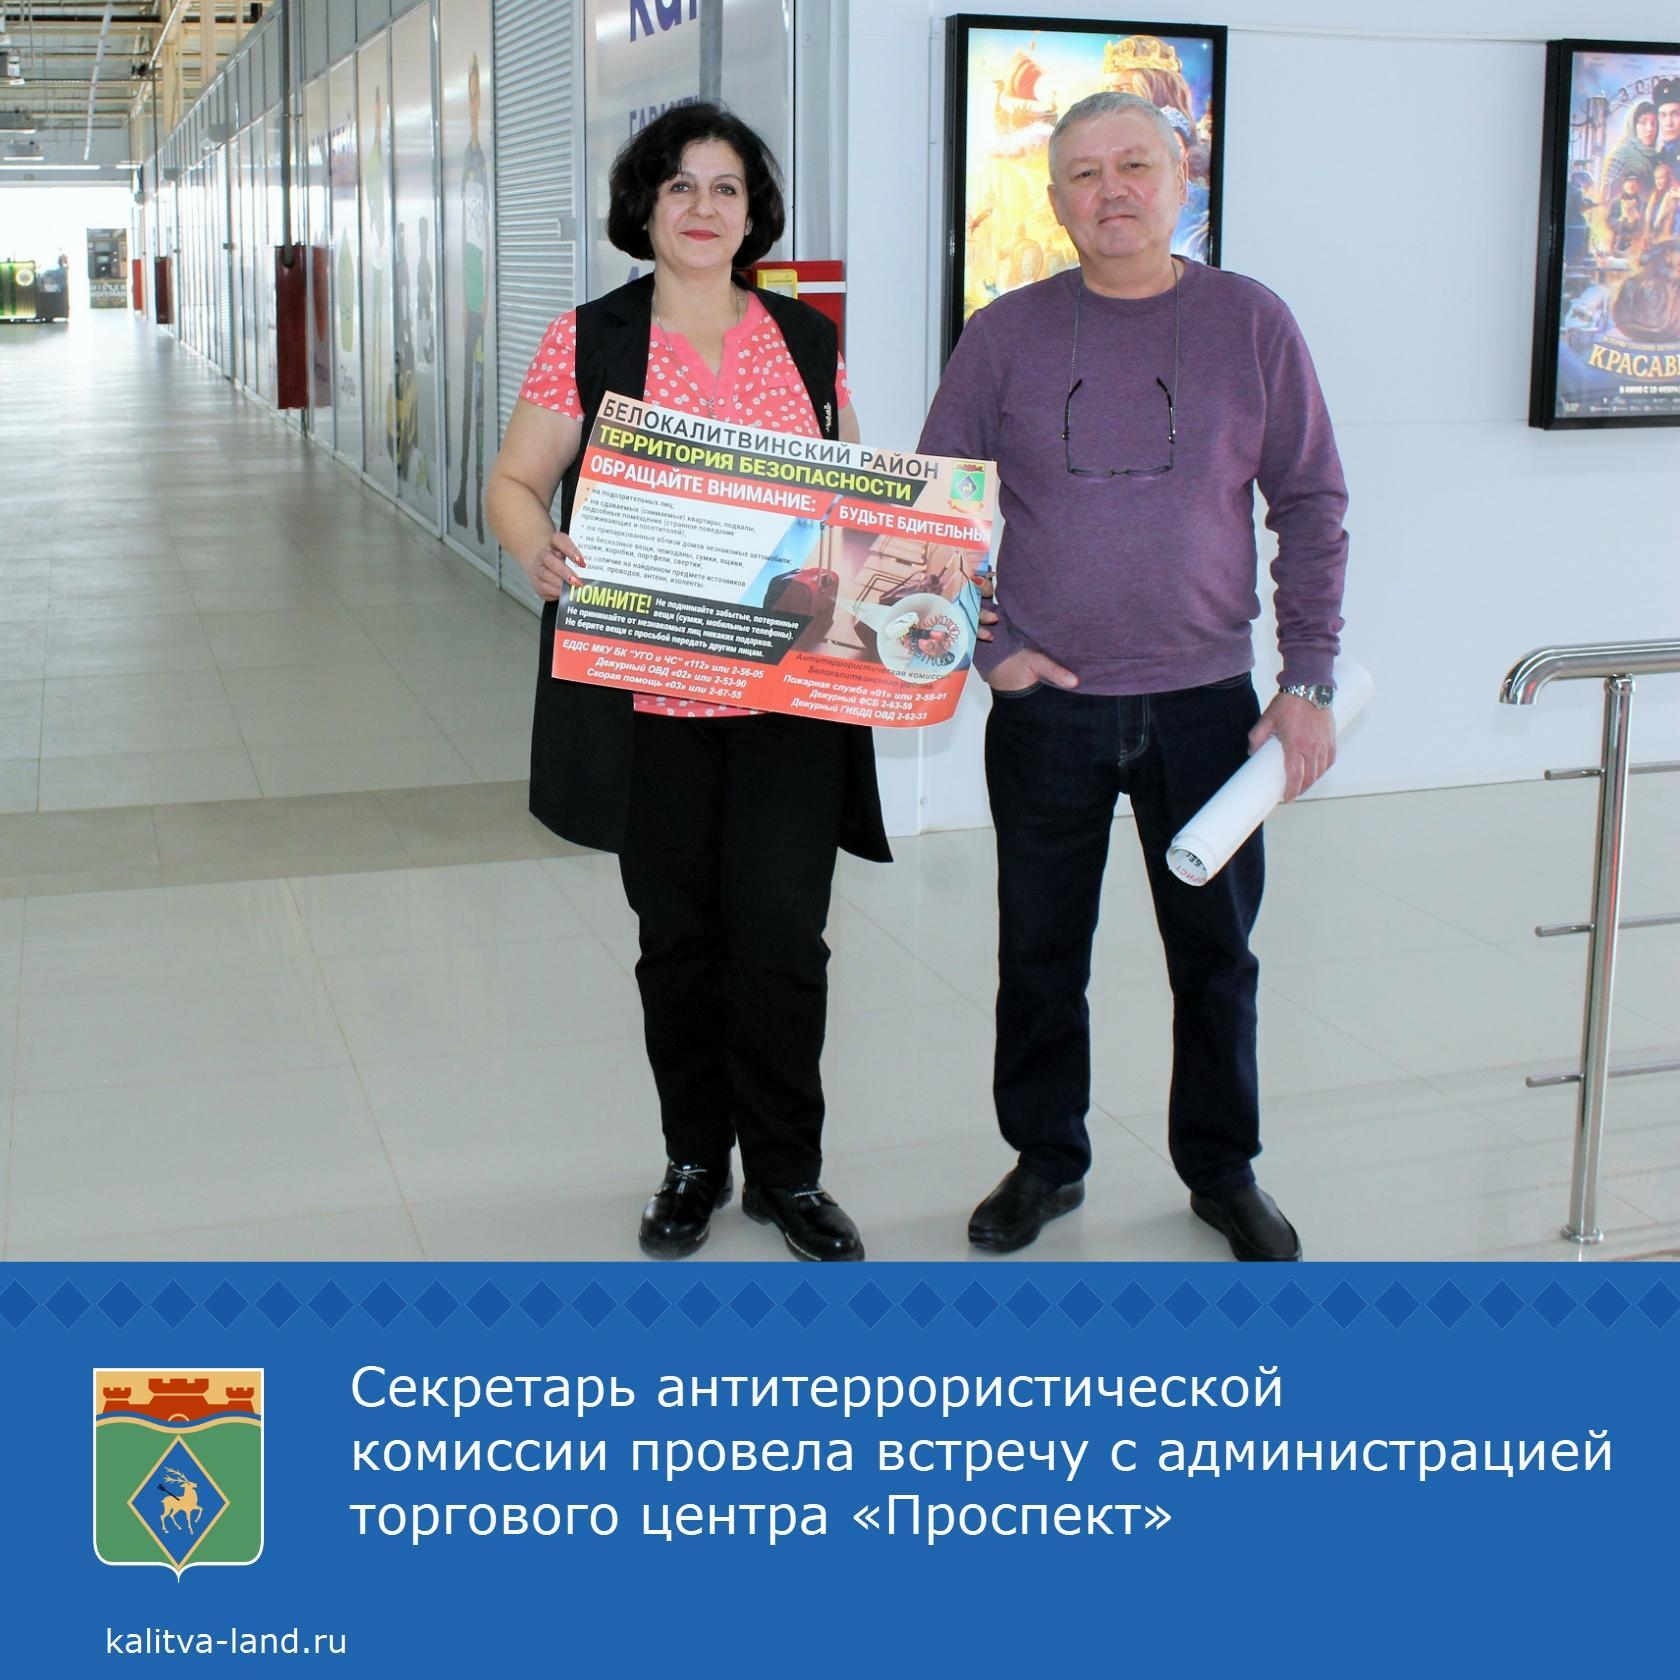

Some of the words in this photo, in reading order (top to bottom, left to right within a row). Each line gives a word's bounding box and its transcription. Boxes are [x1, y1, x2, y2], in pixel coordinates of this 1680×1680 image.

[603, 399, 851, 465] БЕЛОКАЛИТВИНСКИЙ
[860, 451, 940, 480] РАЙОН
[600, 425, 734, 471] ТЕРРИТОРИЯ
[739, 456, 913, 501] БЕЗОПАСНОСТИ
[590, 455, 704, 494] ОБРАЩАЙТЕ
[707, 479, 817, 513] ВНИМАНИЕ:
[602, 490, 658, 506] подозрительных
[582, 506, 621, 518] подсобные
[699, 526, 735, 537] поведение
[600, 501, 639, 512] сдаваемые
[839, 506, 895, 528] БУДЬТЕ
[682, 542, 704, 550] домов
[706, 545, 748, 557] незнакомые
[672, 570, 706, 580] предмете
[706, 576, 746, 588] источников
[569, 585, 652, 614] ПОМНИТЕ!
[656, 598, 666, 606] Не
[668, 602, 714, 615] поднимайте
[715, 610, 752, 622] забытые,
[753, 616, 800, 630] потерянные
[654, 611, 675, 620] вещи
[676, 612, 704, 626] (сумки,
[706, 620, 750, 632] мобильные
[565, 617, 576, 626] Не
[577, 620, 604, 631] берите
[605, 626, 627, 636] вещи
[634, 630, 670, 642] просьбой
[672, 636, 708, 648] передать
[708, 643, 737, 654] другим
[567, 606, 578, 615] Не
[579, 608, 626, 623] принимайте
[638, 619, 687, 634] незнакомых
[688, 628, 702, 637] лиц
[702, 630, 734, 642] никаких
[562, 639, 590, 652] ЕДДС
[591, 643, 614, 654] МКУ
[614, 648, 628, 657] БК
[684, 659, 710, 670] «112»
[712, 664, 730, 673] или
[587, 668, 622, 681] Скорая
[623, 674, 662, 688] помощь
[665, 680, 686, 690] «03»
[688, 686, 706, 694] или
[709, 687, 742, 700] 2-67-55
[595, 657, 646, 672] Дежурный
[648, 665, 670, 678] ОВД
[671, 669, 692, 680] «02»
[694, 674, 712, 682] или
[714, 676, 747, 688] 2-53-90
[784, 674, 831, 689] Пожарная
[832, 684, 868, 696] служба
[870, 689, 892, 698] «01»
[894, 693, 913, 701] или
[791, 698, 838, 712] Дежурный
[840, 704, 873, 718] ГИБДД
[874, 710, 896, 721] ОВД
[809, 689, 856, 704] Дежурный
[859, 697, 880, 706] ФСБ
